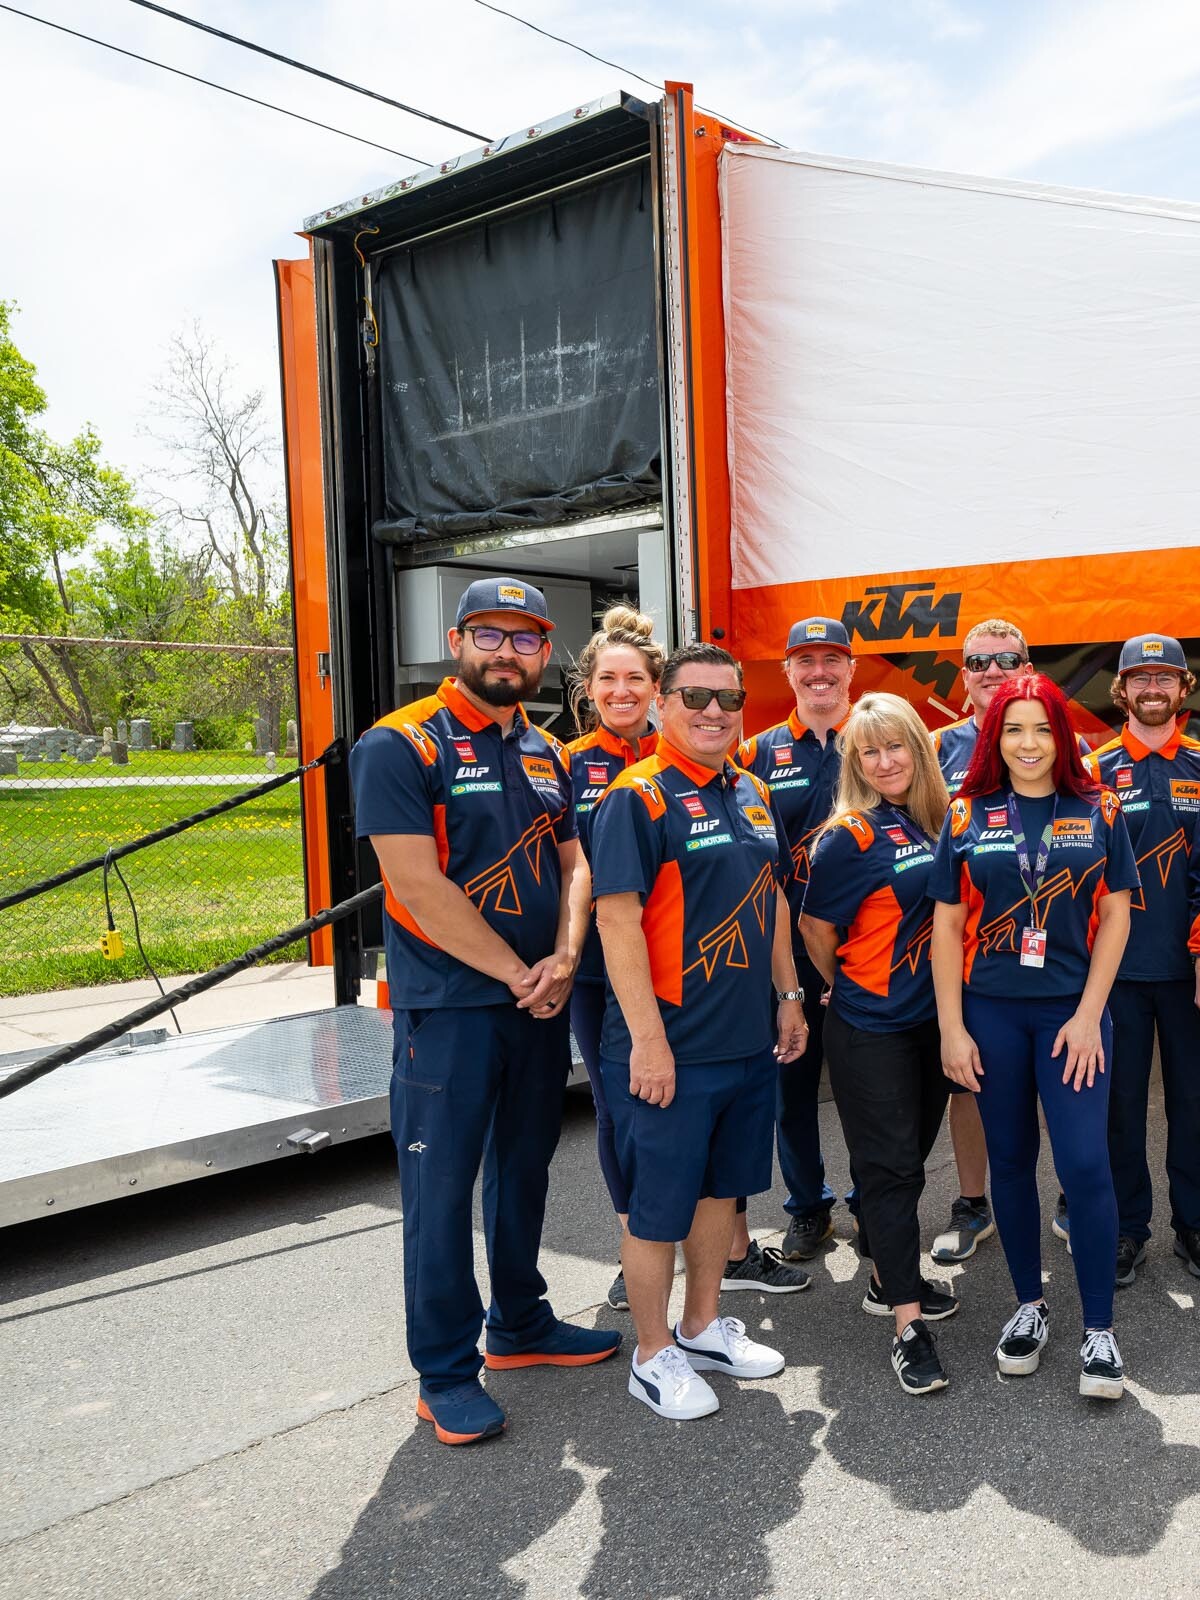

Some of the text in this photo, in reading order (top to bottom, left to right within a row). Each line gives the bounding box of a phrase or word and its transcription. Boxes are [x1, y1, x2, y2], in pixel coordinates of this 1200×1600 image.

[841, 582, 962, 642] KTM
[455, 767, 490, 779] WP
[529, 763, 551, 774] KTM
[770, 766, 803, 780] WP
[465, 782, 501, 793] MOTOREX
[775, 779, 808, 789] MOTOREX
[1175, 784, 1199, 795] KTM
[1123, 802, 1148, 812] OTOREX
[752, 811, 767, 821] KTM
[690, 819, 720, 834] WP
[1057, 822, 1086, 832] KTM
[700, 834, 731, 847] MOTOREX
[979, 830, 1013, 840] WP
[895, 845, 923, 859] WP
[984, 843, 1016, 853] MOTORE
